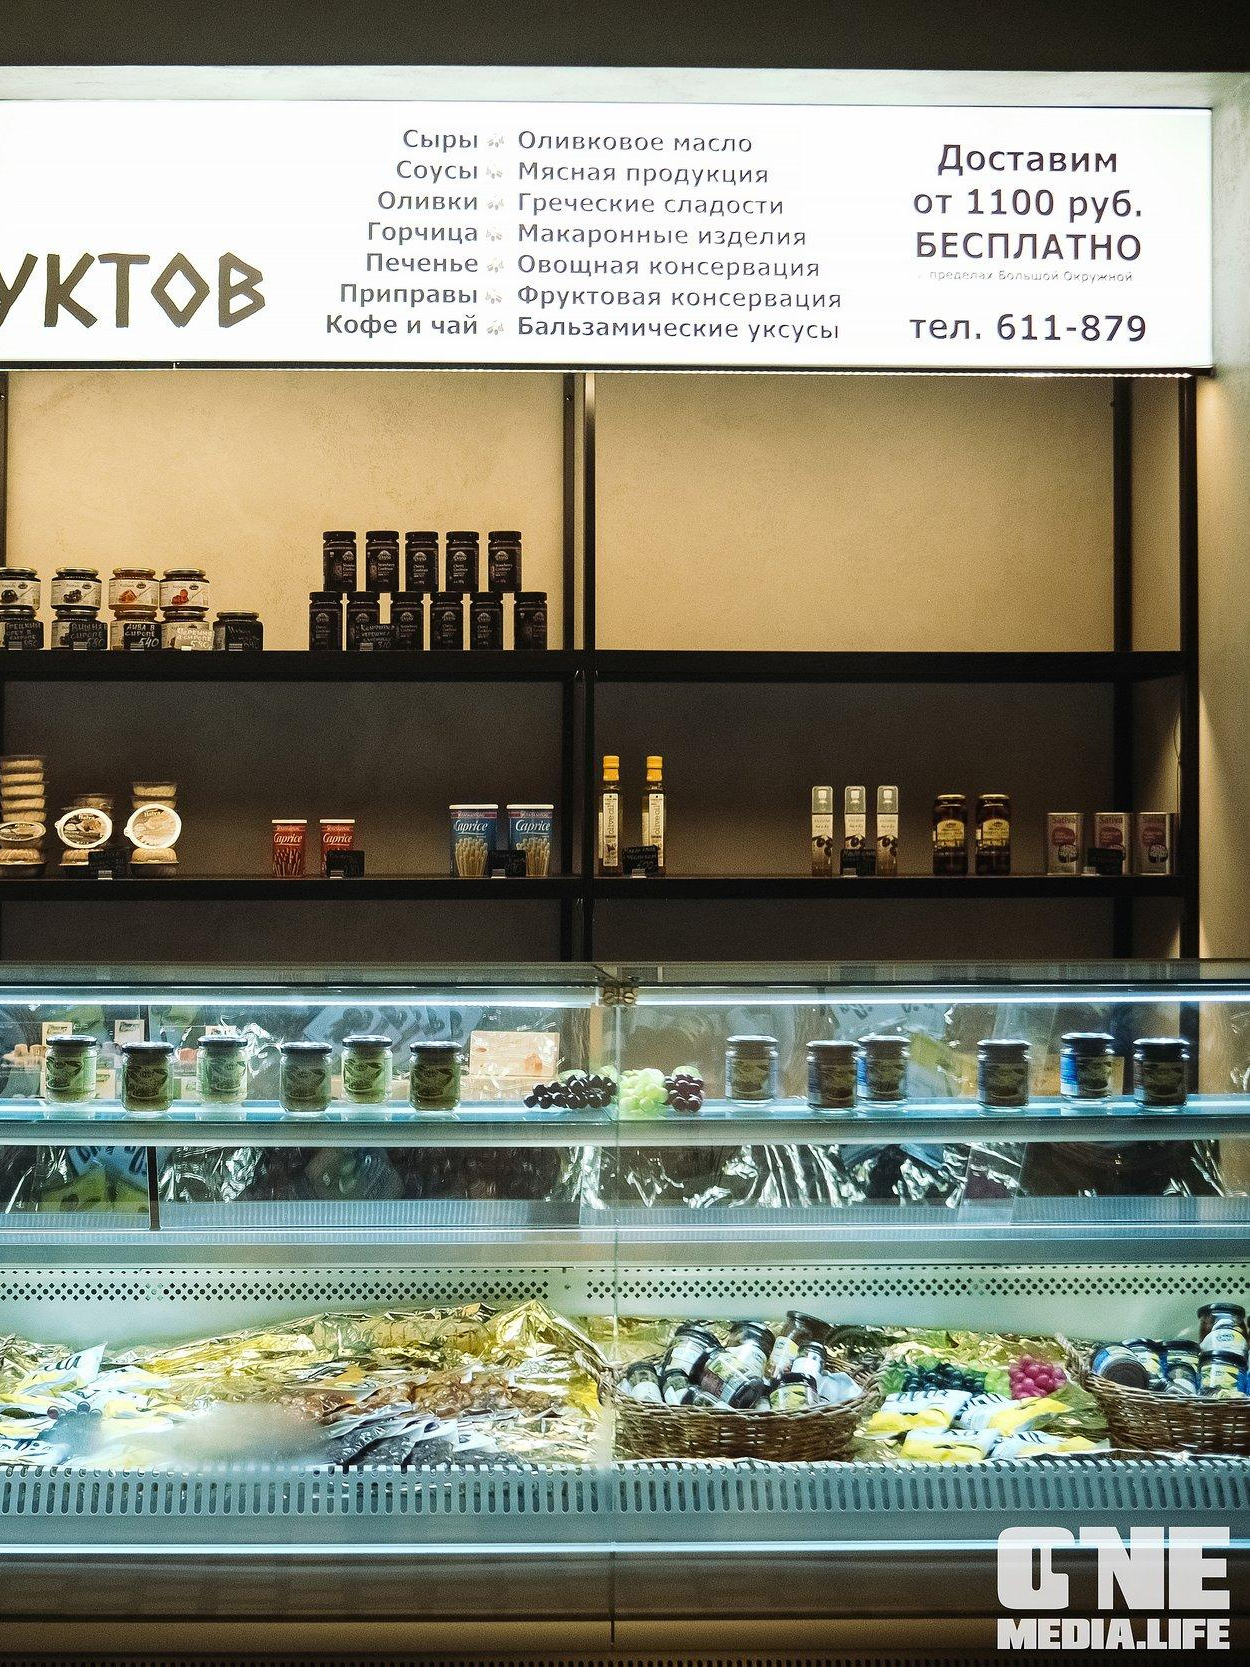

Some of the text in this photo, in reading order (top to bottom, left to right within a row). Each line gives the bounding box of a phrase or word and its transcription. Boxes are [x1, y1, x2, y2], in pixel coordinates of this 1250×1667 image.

[403, 129, 477, 153] Сыры
[519, 131, 752, 152] Оливковое масло
[397, 160, 477, 184] Соусы
[938, 144, 1117, 176] Доставим
[519, 162, 768, 188] Мясная продукция
[378, 190, 477, 211] Оливки
[519, 193, 783, 217] Греческие сладости
[914, 189, 1142, 224] от 1100 руб.
[367, 222, 477, 246] Горчица
[519, 224, 806, 249] Макаронные изделия
[917, 231, 1141, 261] БЕСПЛАТНО
[367, 253, 478, 273] Печенье
[518, 255, 819, 281] Овощная консервация
[930, 271, 993, 282] пределах
[998, 269, 1059, 282] Большой
[1064, 270, 1133, 284] Окружной
[341, 284, 477, 309] Приправы
[518, 286, 841, 312] Фруктовая консервация
[327, 313, 478, 338] Кофе и чай
[518, 317, 839, 343] Бальзамические уксусы
[908, 313, 1147, 342] тел. 611-879
[138, 637, 160, 648] 540
[273, 832, 303, 844] Caprice
[322, 832, 353, 844] Caprice
[454, 820, 488, 833] Caprice
[516, 820, 551, 833] Caprice
